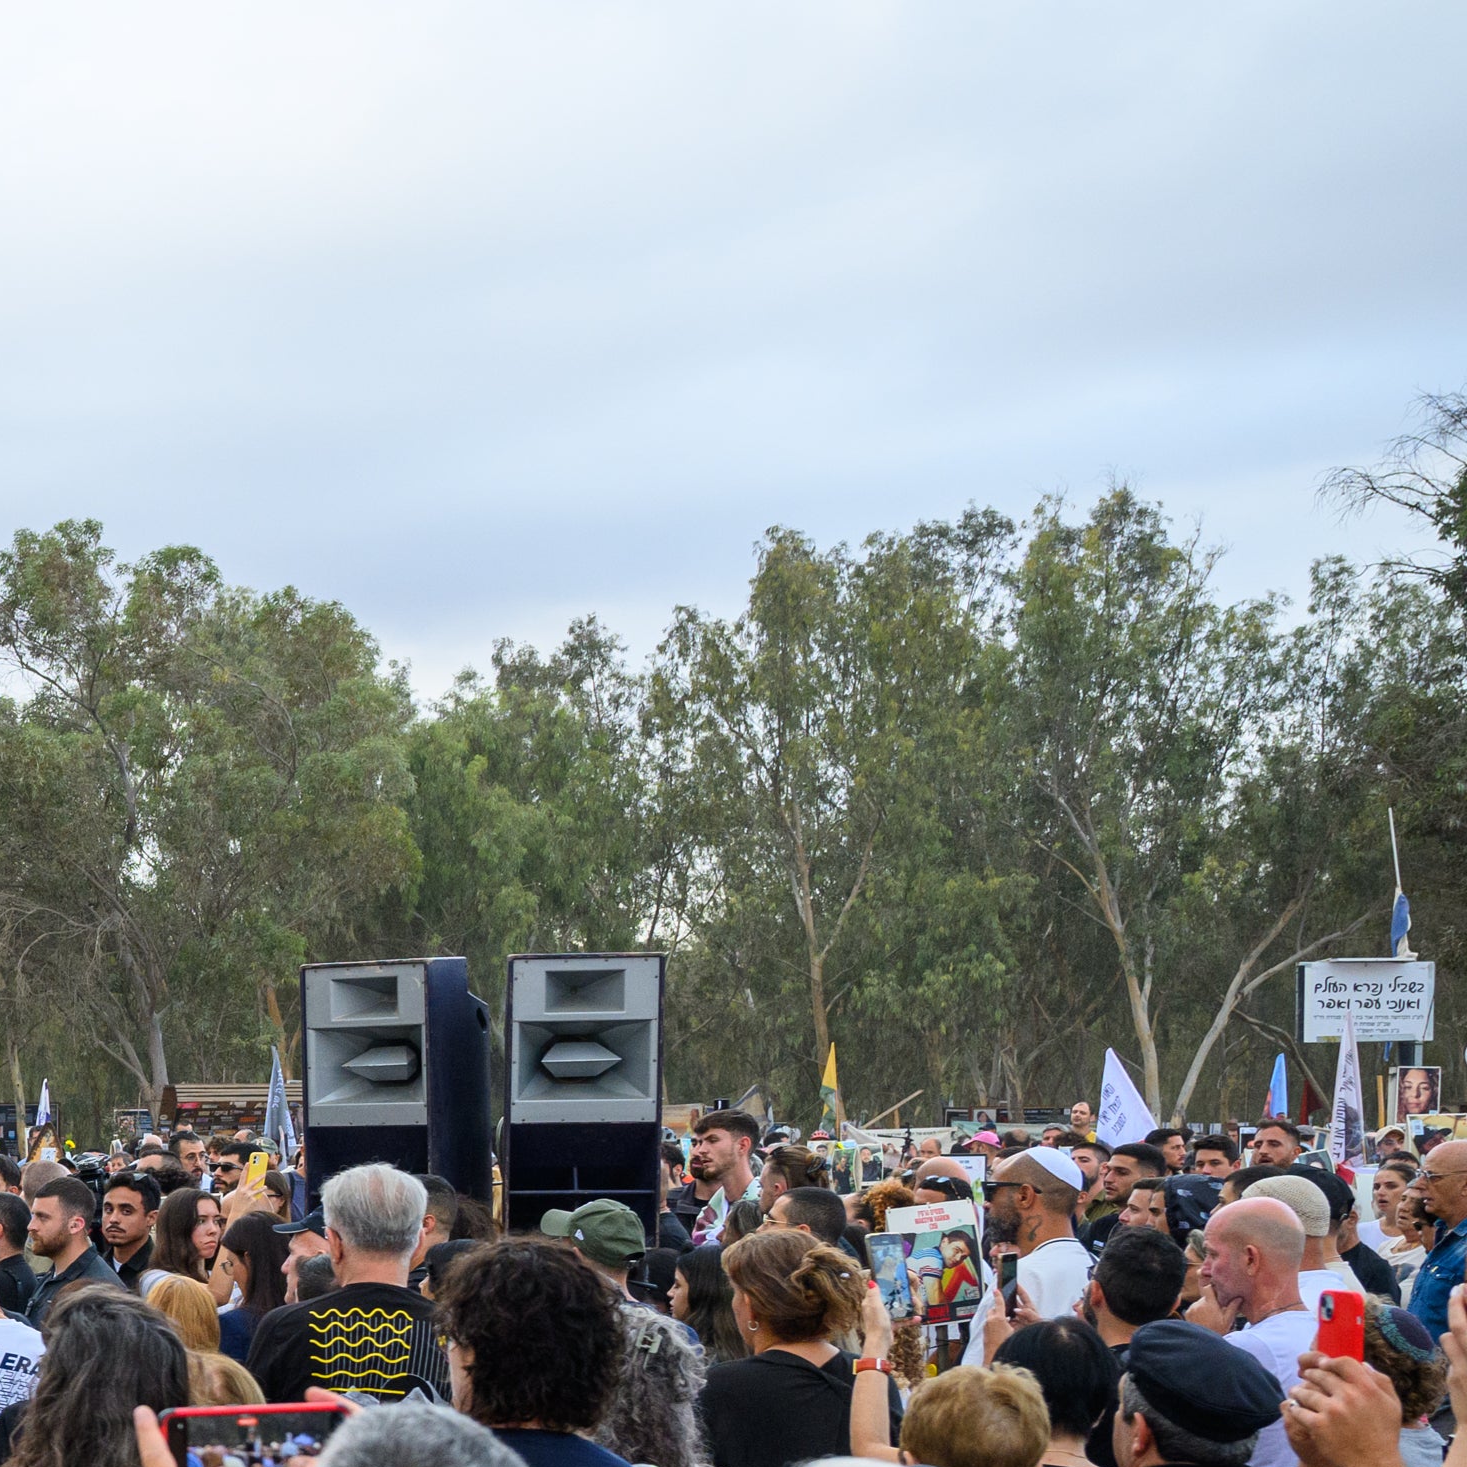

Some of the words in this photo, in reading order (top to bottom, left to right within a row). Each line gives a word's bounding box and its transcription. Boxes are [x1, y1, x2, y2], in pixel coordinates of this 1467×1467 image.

[1314, 976, 1348, 994] העולם
[1353, 982, 1383, 996] נברא
[1388, 976, 1425, 993] בשבילי
[1317, 998, 1350, 1010] ואפר
[1355, 998, 1381, 1010] עפר
[1386, 999, 1420, 1013] ואנוכי
